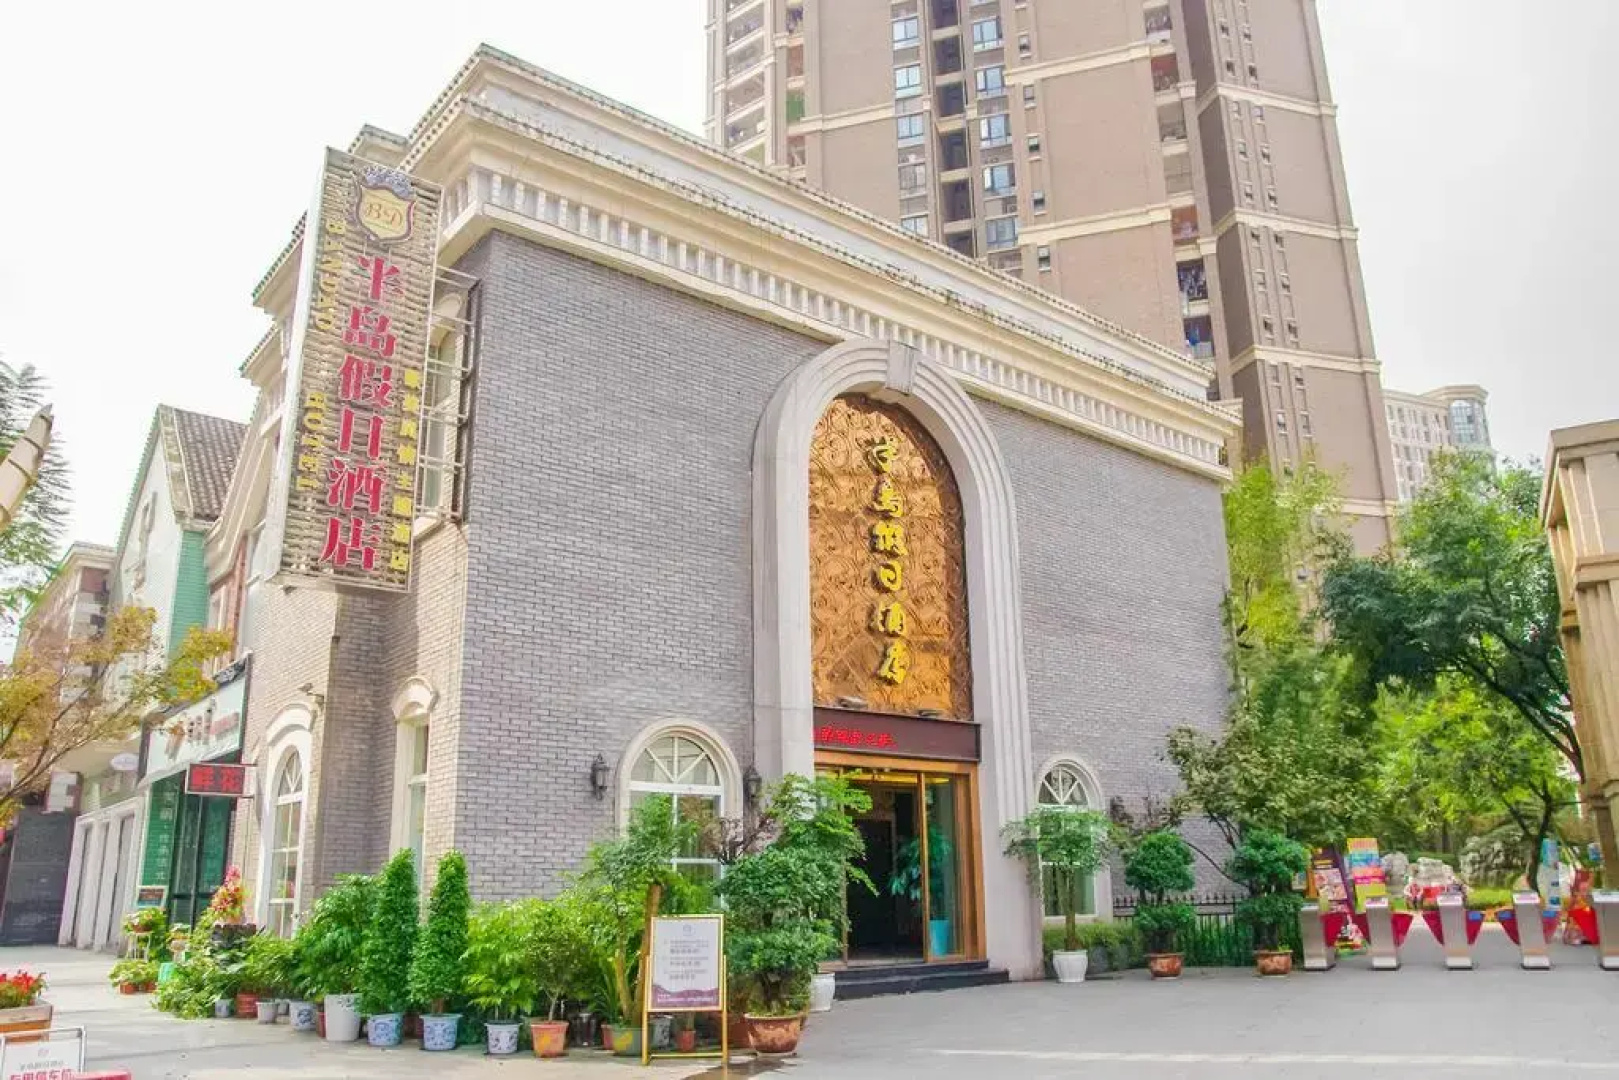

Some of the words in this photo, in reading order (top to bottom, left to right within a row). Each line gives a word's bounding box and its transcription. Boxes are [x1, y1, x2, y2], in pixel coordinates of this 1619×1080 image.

[314, 219, 346, 330] BANDAO
[295, 390, 328, 491] HOTEL
[318, 255, 404, 571] 半岛假日酒店
